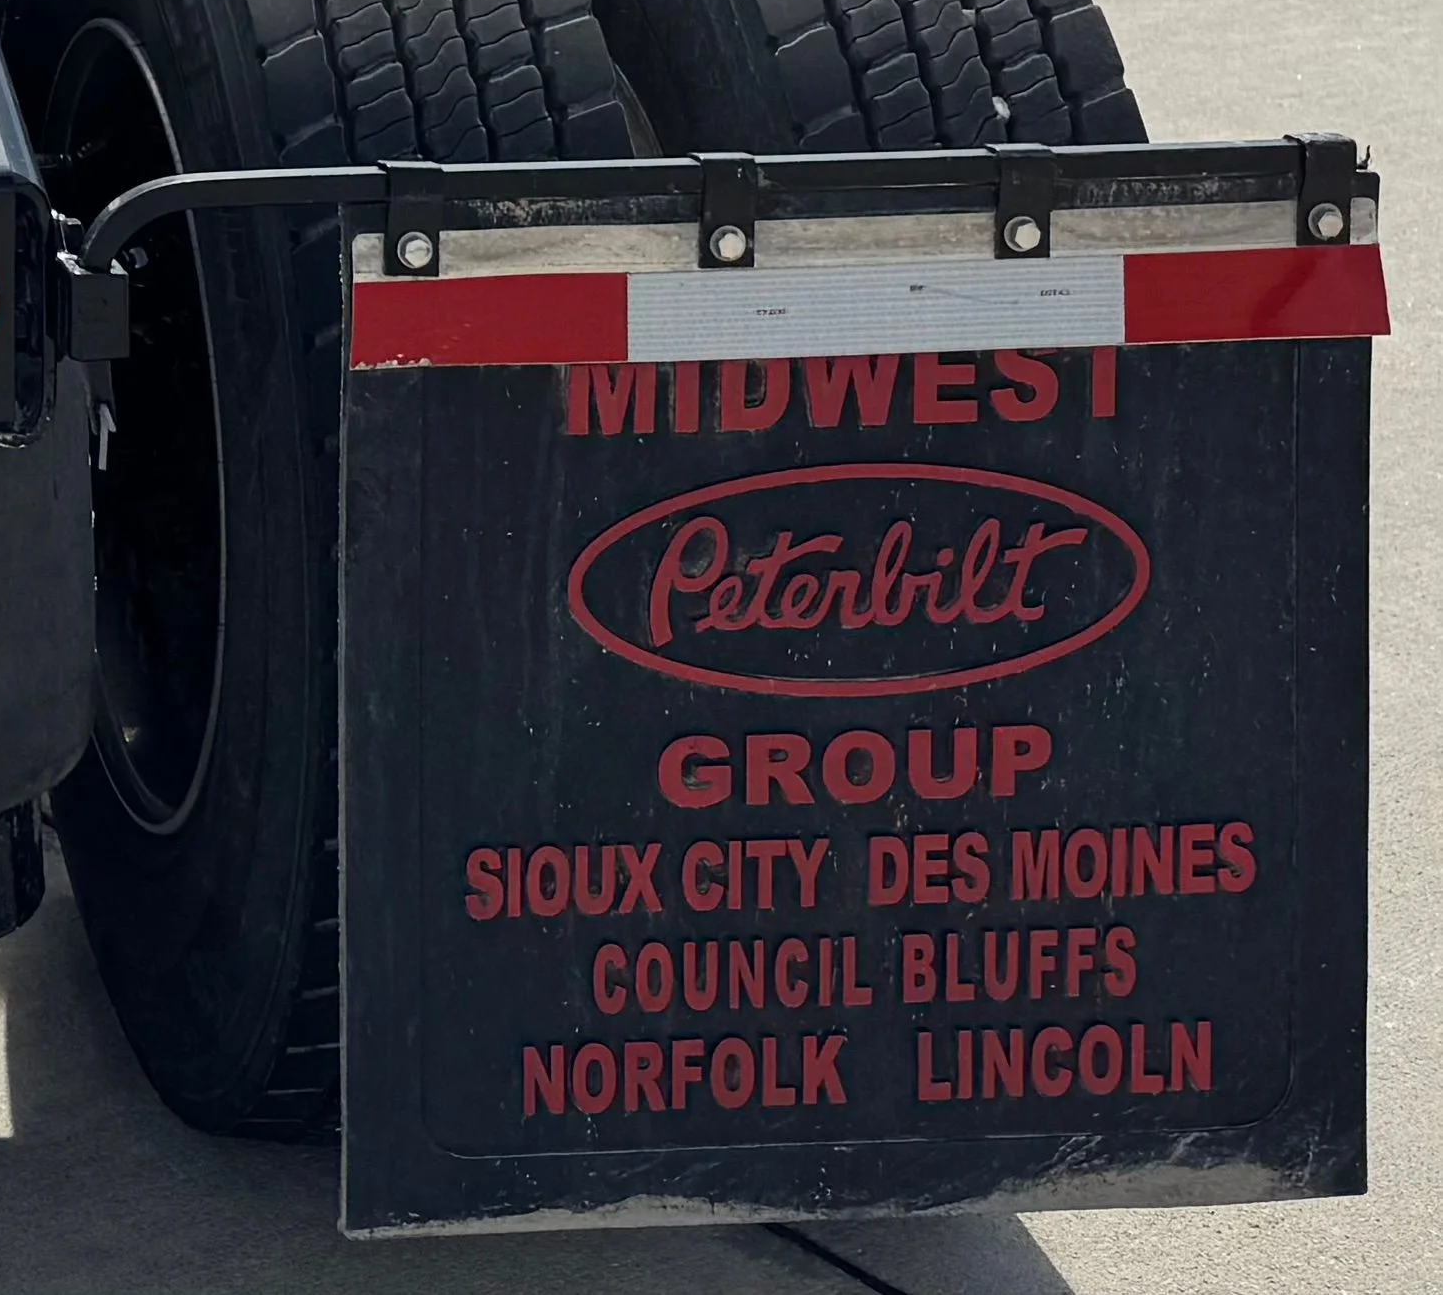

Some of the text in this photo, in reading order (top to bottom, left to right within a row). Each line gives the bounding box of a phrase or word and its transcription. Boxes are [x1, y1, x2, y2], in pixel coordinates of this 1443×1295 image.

[649, 514, 1087, 647] Peterbilt
[657, 724, 1053, 808] GROUP
[465, 821, 1257, 920] SIOUX CITY DES MOINES
[593, 927, 1137, 1014] COUNCIL BLUFFS
[522, 1021, 1213, 1115] NORFOLK LINCOLN
